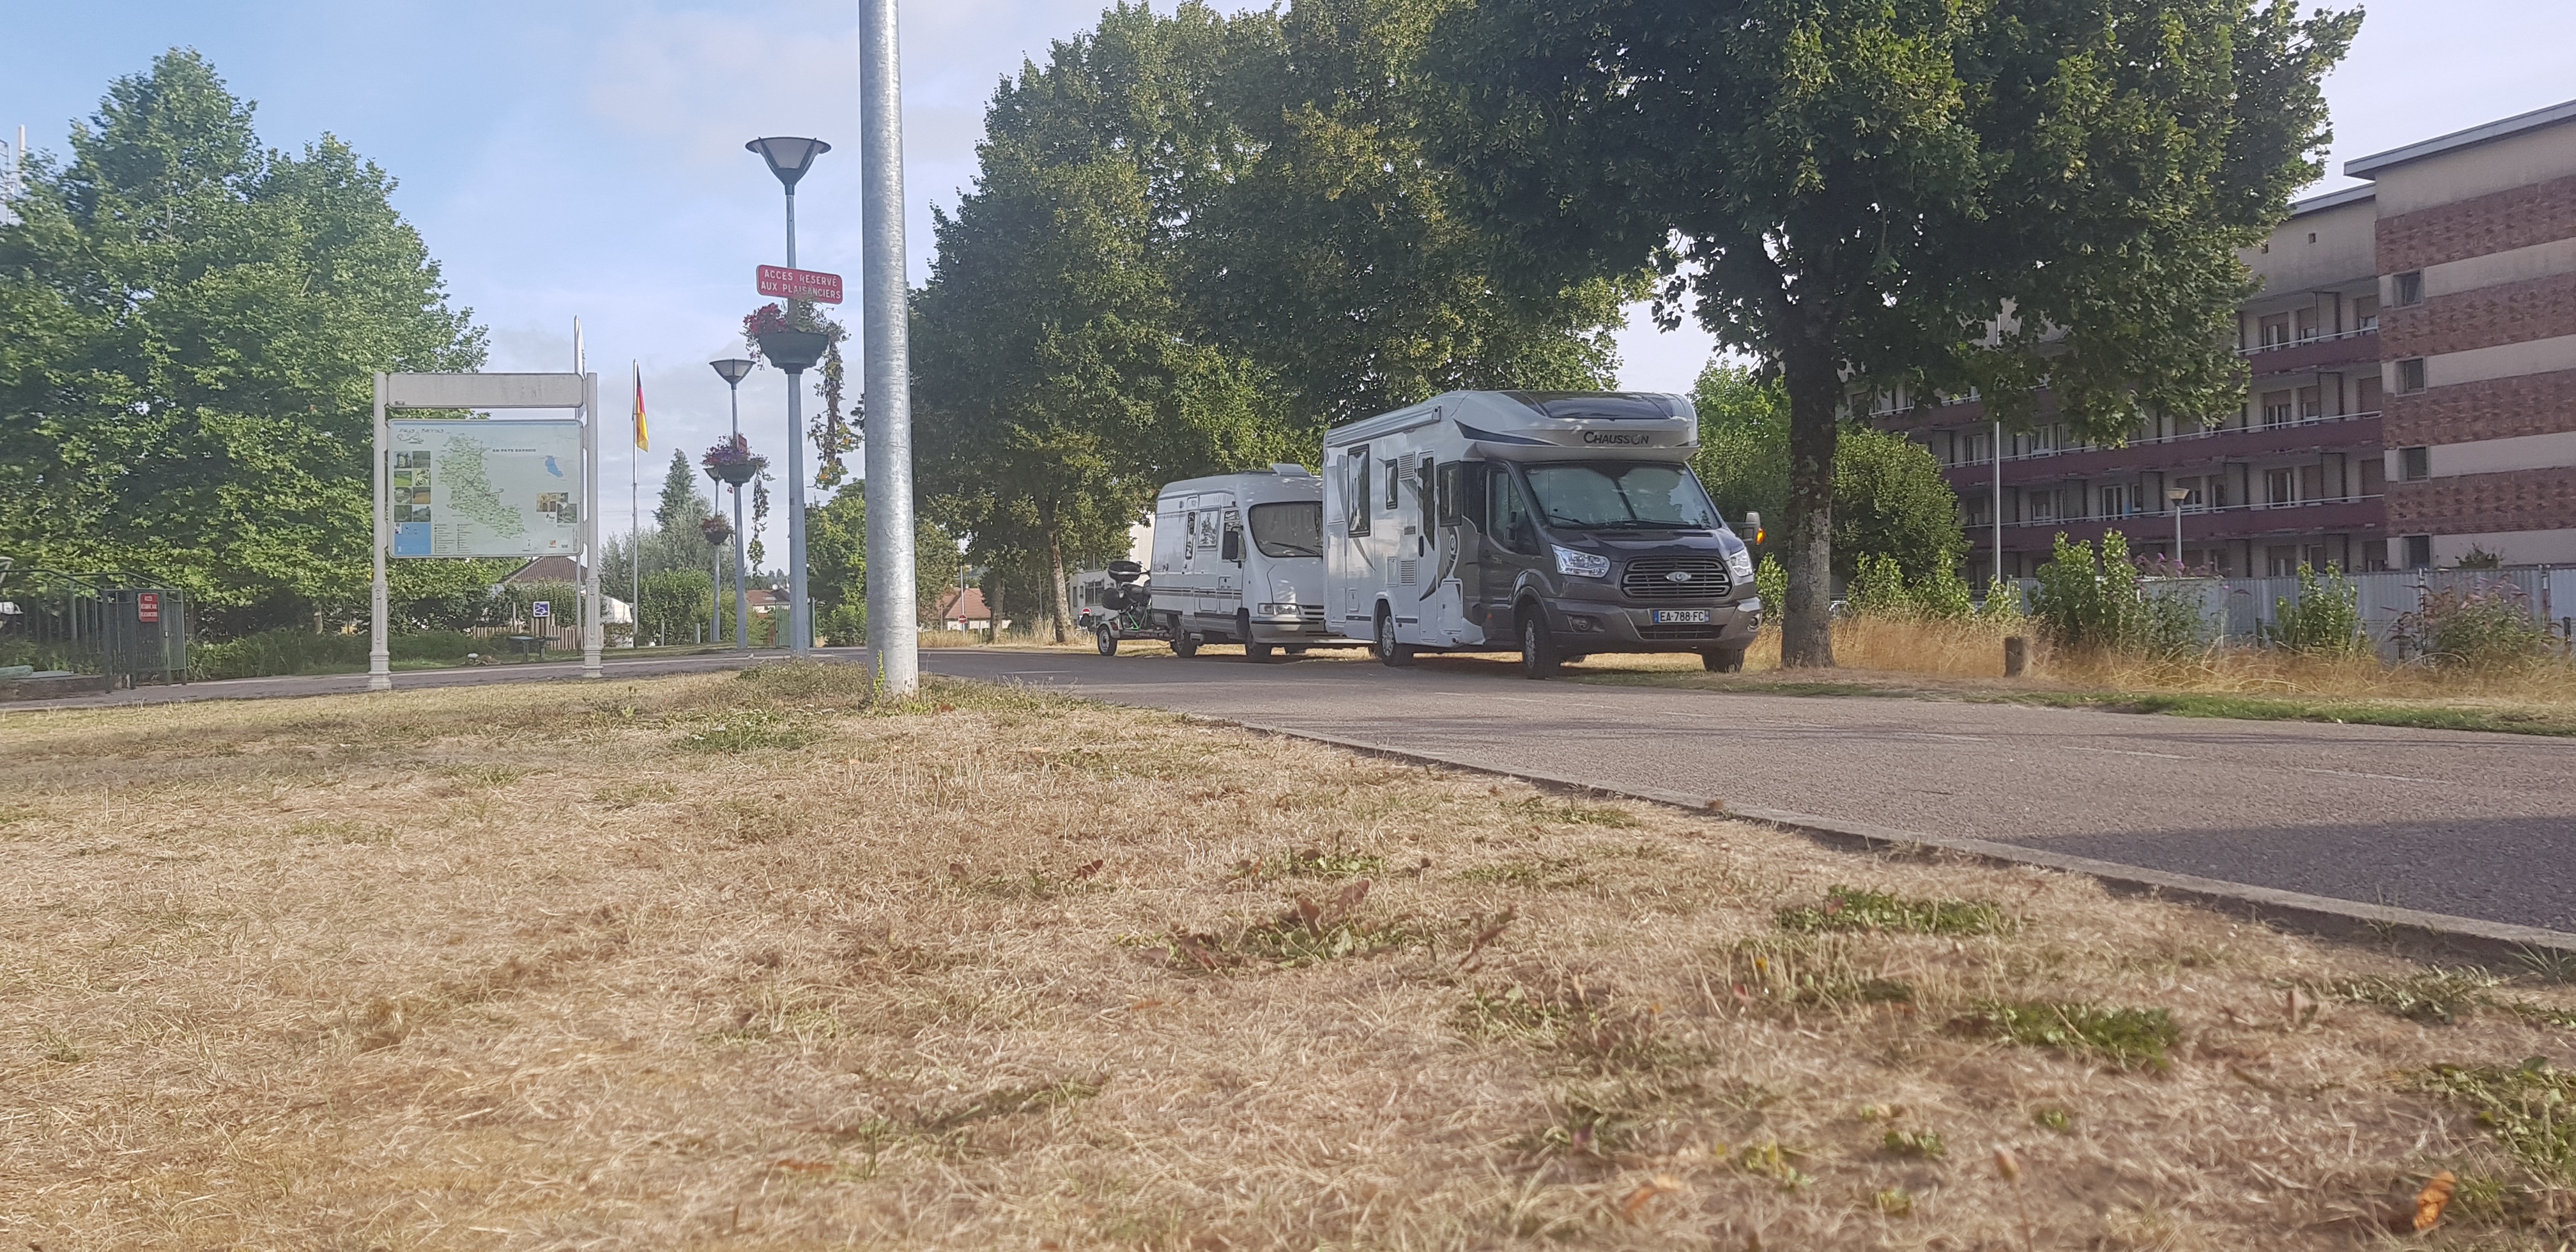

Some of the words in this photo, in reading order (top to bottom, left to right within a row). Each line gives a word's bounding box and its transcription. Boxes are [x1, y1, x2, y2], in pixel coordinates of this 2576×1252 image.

[764, 269, 793, 281] ACCES
[761, 281, 778, 291] AUX
[782, 284, 841, 300] PLAISANCIERS
[1583, 431, 1649, 445] CHAUSSON
[1660, 612, 1704, 621] EA-788-FC
